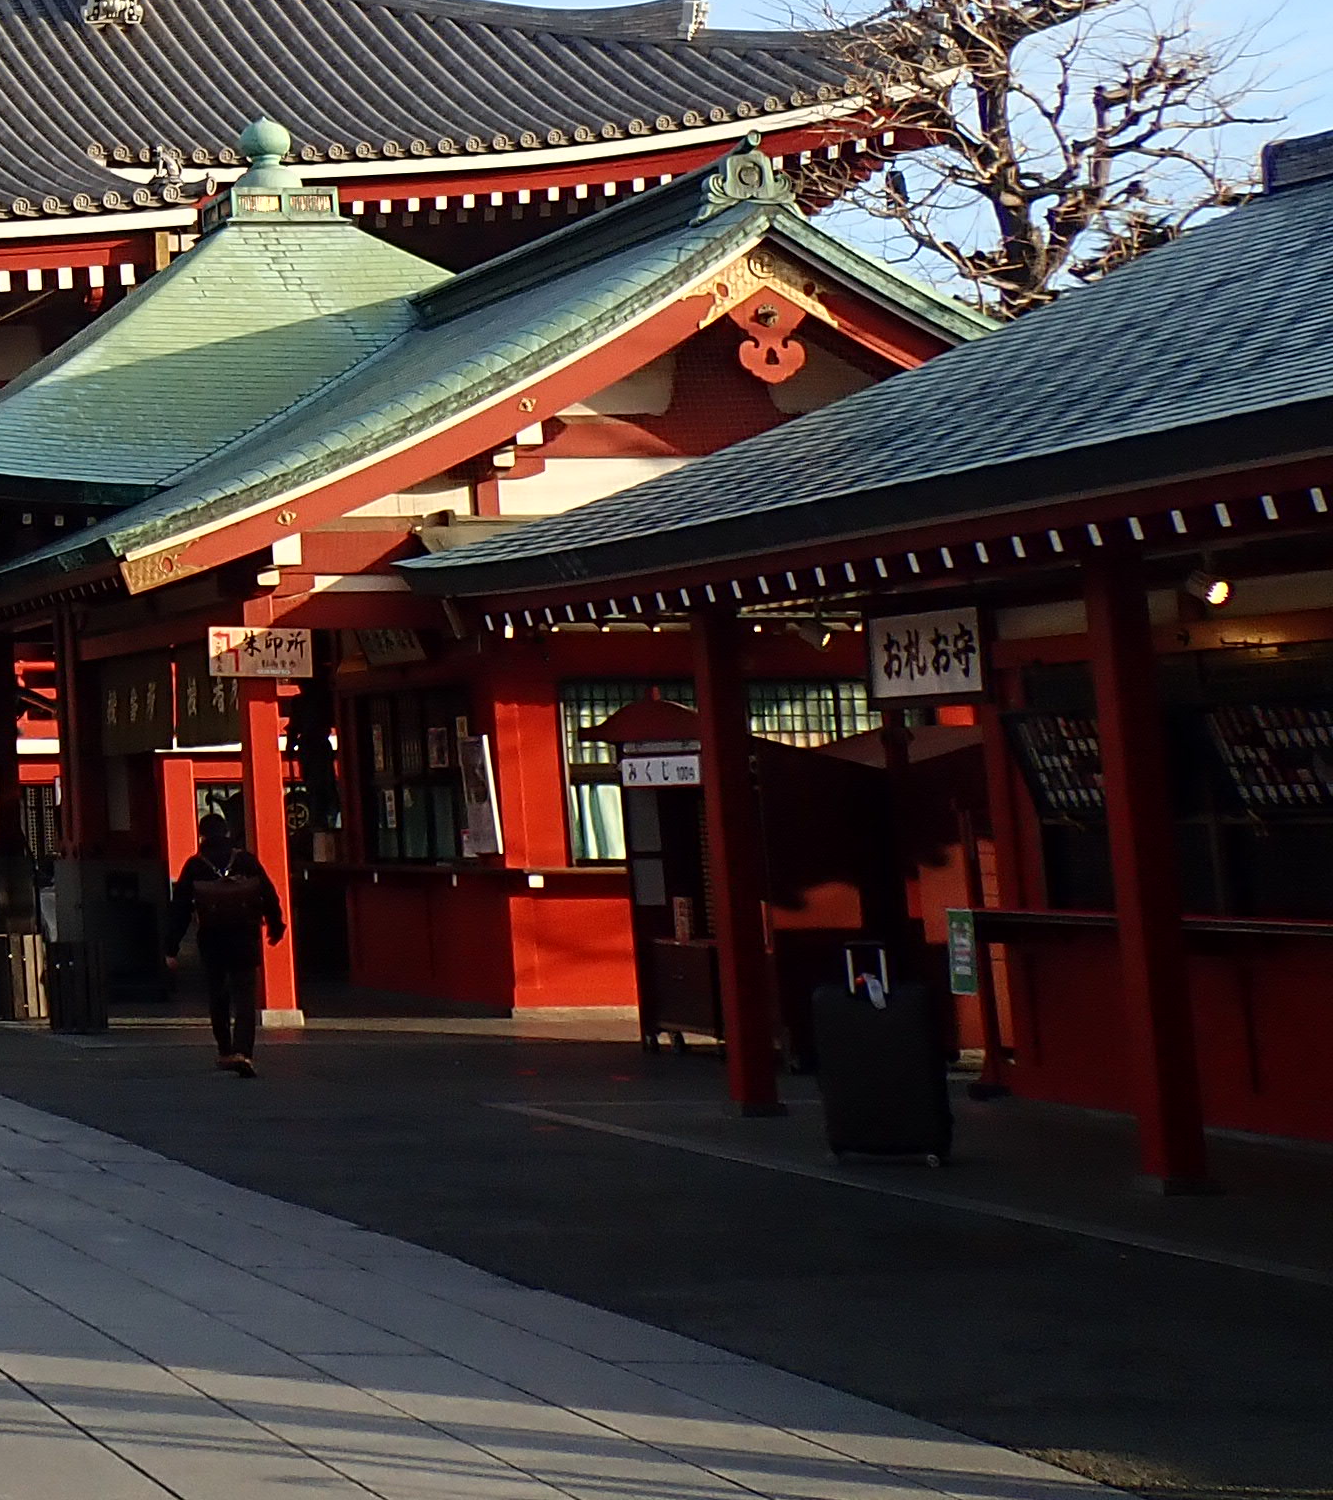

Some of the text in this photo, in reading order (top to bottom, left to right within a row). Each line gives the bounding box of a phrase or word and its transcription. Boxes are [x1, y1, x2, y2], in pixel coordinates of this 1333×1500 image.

[243, 630, 306, 659] 朱印所
[883, 622, 976, 681] お札お守
